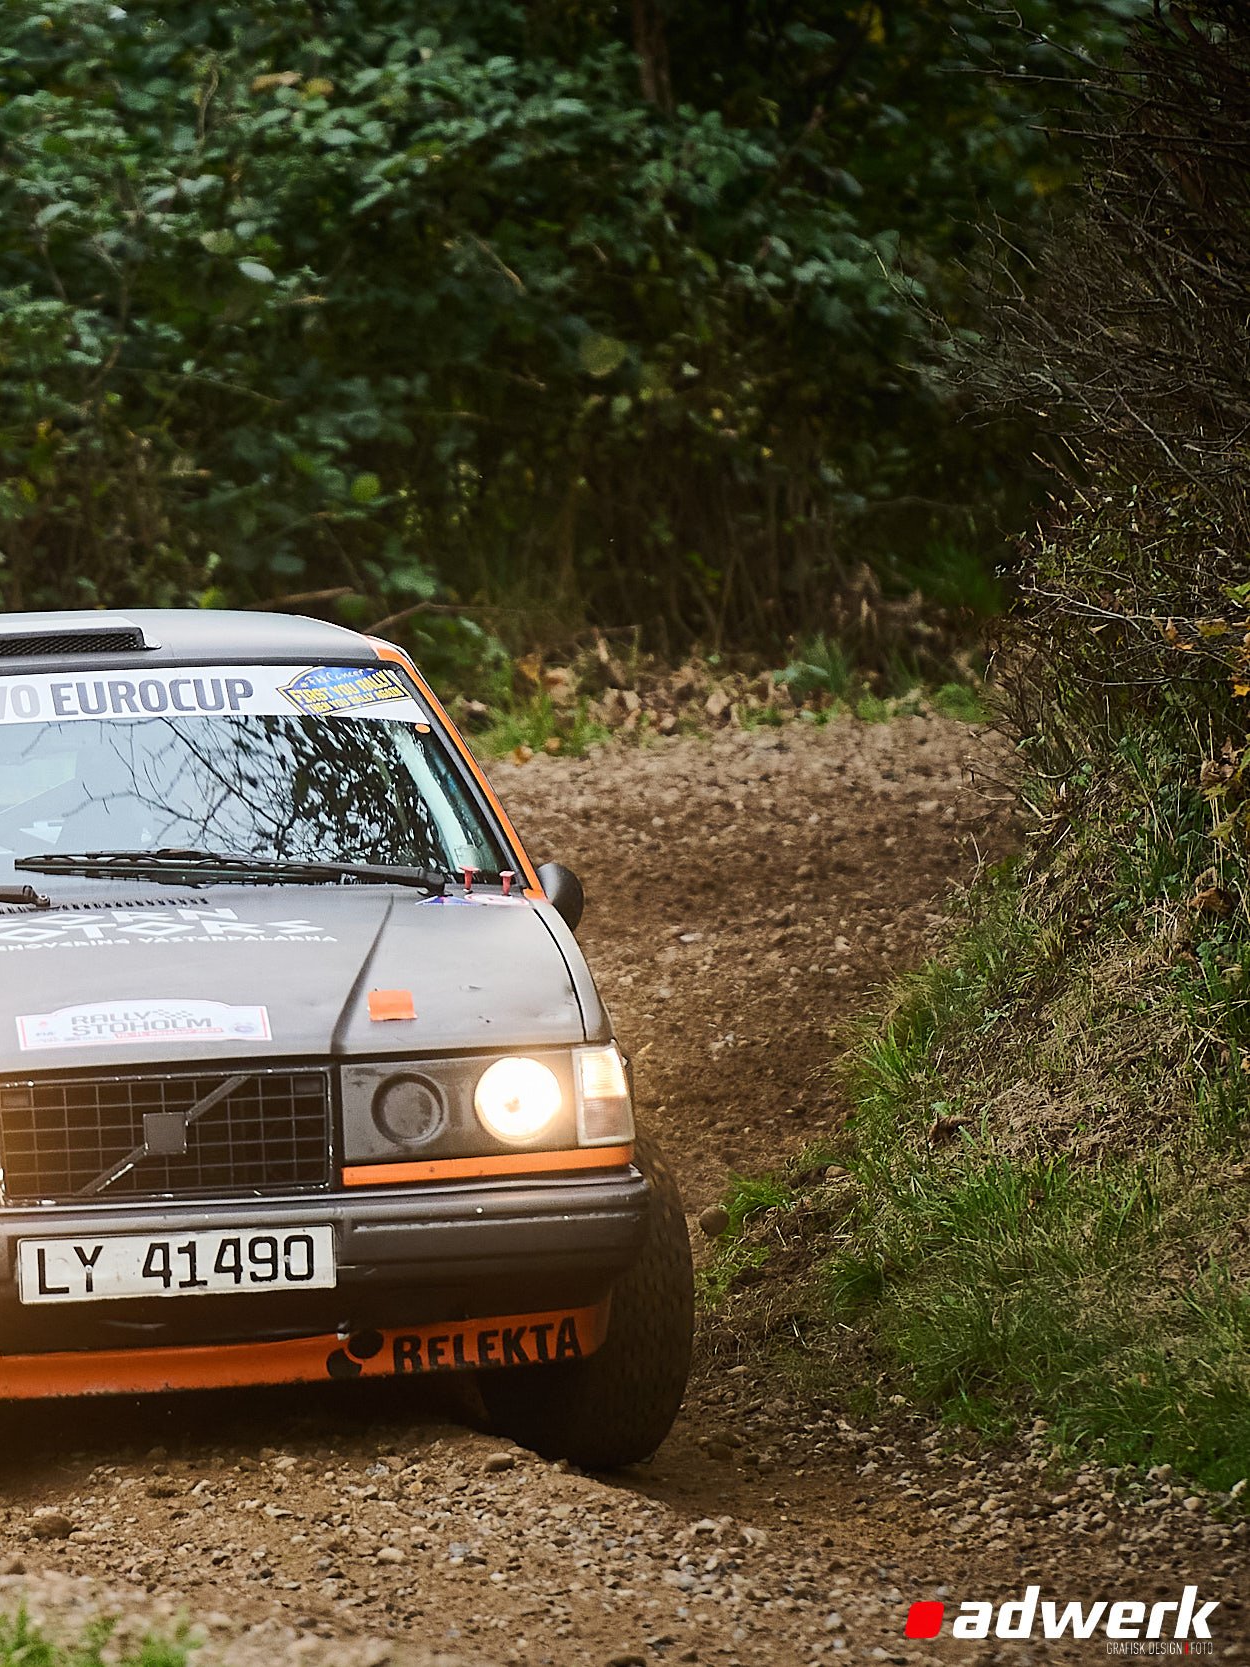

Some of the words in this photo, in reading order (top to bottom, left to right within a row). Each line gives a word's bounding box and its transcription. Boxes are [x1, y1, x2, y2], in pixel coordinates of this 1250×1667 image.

[50, 679, 254, 716] EUROCUP
[288, 687, 333, 704] FIRST
[330, 682, 361, 698] YOU
[355, 669, 392, 691] RALLY
[71, 1009, 151, 1025] RALLY
[71, 1017, 213, 1037] STOHOLM
[37, 1244, 104, 1295] LY
[142, 1234, 314, 1289] 41490
[393, 1316, 582, 1374] RELEKTA
